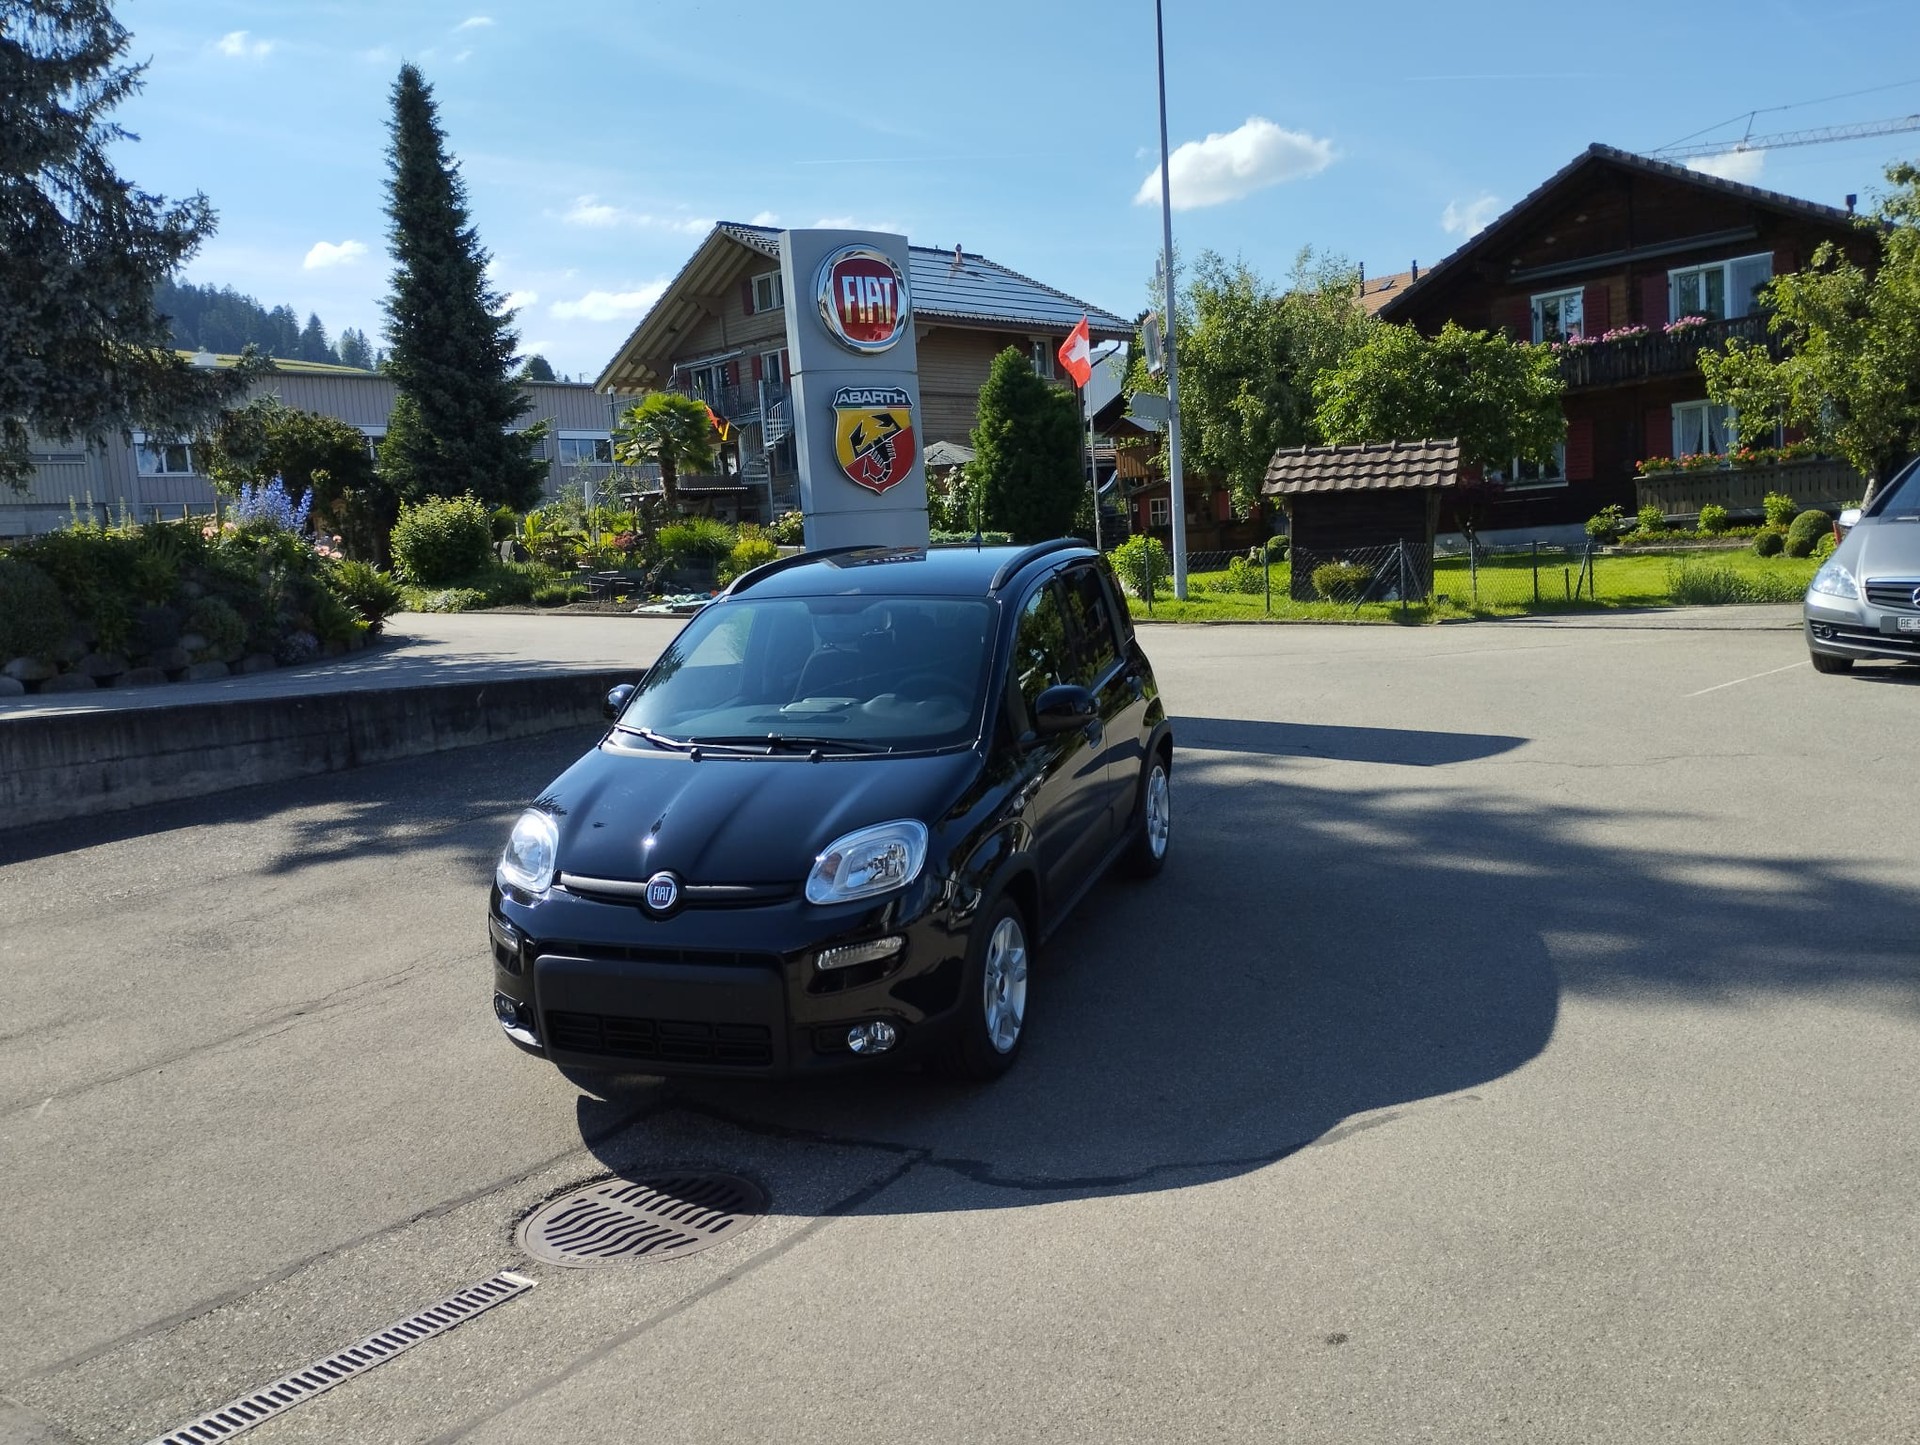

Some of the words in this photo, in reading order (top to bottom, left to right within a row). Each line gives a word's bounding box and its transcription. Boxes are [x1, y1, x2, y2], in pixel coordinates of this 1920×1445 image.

[841, 275, 893, 324] FIAT
[838, 391, 906, 404] ABARTH
[1900, 618, 1912, 628] BE
[653, 886, 671, 901] FIAT
